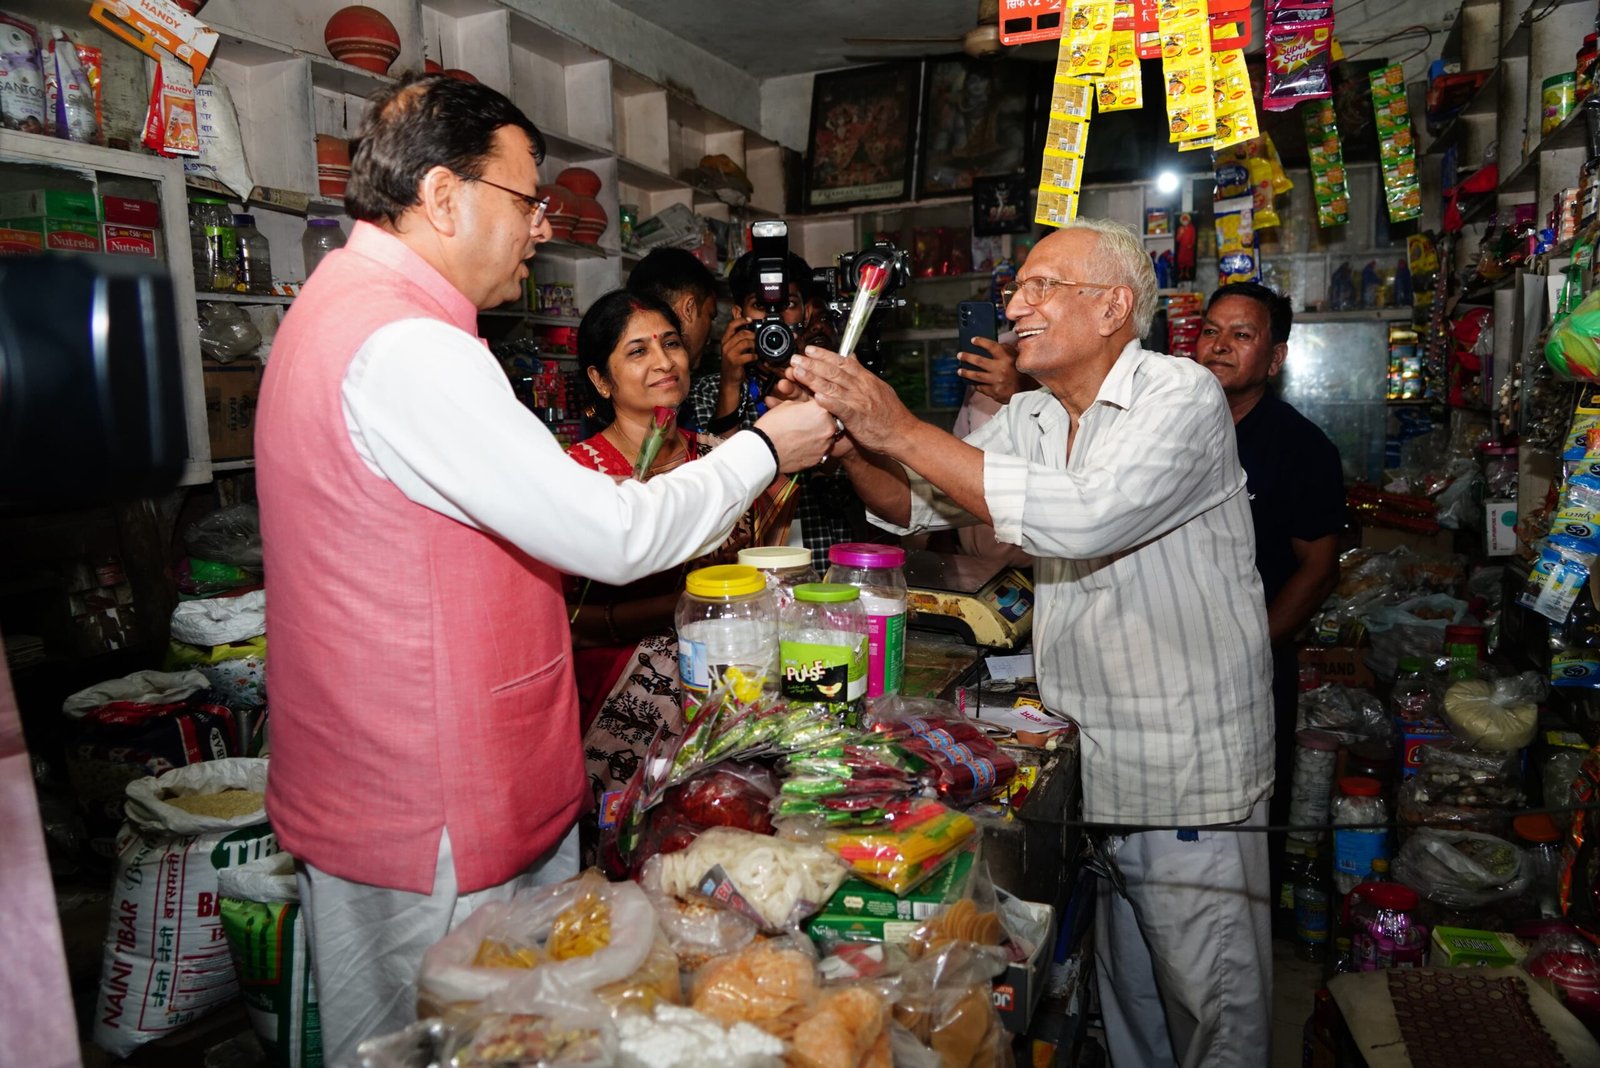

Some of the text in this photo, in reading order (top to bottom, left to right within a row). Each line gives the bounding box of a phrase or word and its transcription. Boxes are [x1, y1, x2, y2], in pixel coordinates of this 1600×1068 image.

[140, 0, 181, 29] HANDY
[1280, 42, 1307, 56] Super
[1283, 49, 1312, 64] Scrub
[163, 83, 193, 95] HANDY
[52, 235, 95, 250] Nutrela
[111, 240, 150, 255] Nutrela
[786, 659, 826, 682] PULSE
[115, 899, 138, 954] TIBAR
[102, 960, 133, 1029] NAINI
